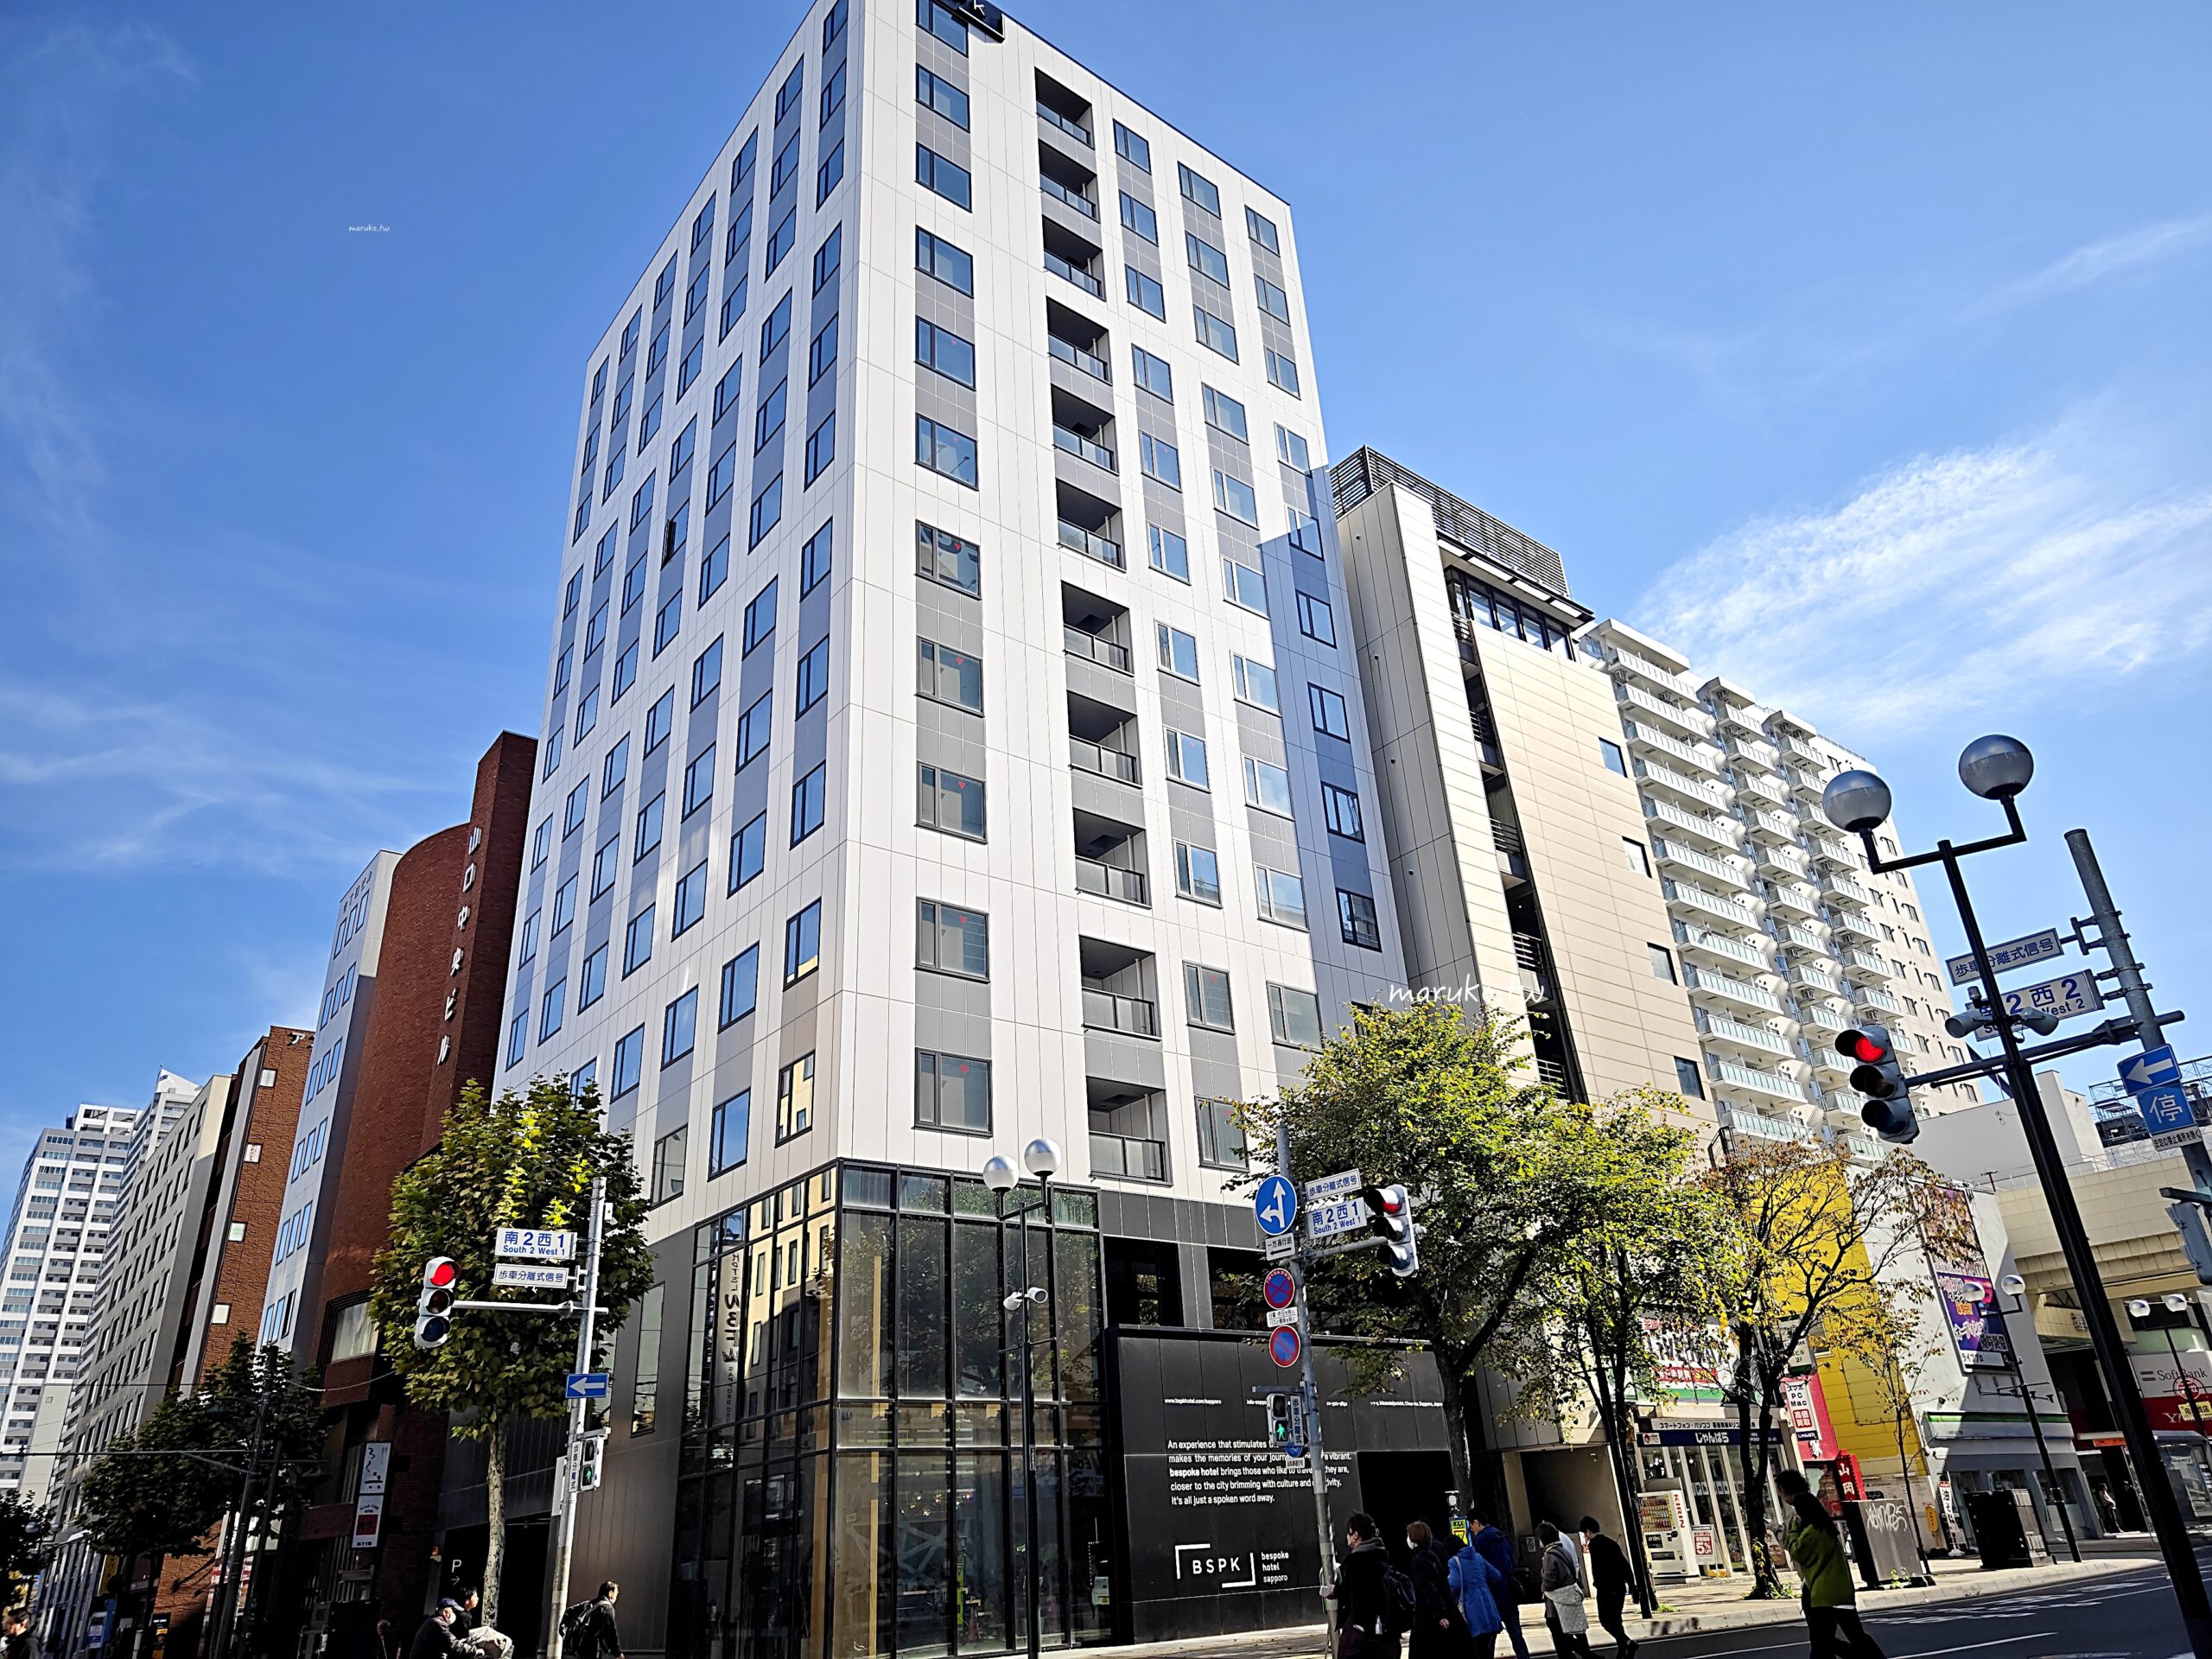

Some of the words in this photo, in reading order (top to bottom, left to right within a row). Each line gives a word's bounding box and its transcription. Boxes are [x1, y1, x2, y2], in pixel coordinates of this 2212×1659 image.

[436, 826, 482, 1066] 山口中央ビル
[2076, 998, 2086, 1009] 2
[2149, 1094, 2183, 1124] 停
[1308, 1178, 1358, 1196] 歩車分離式信号
[1313, 1224, 1332, 1236] South
[1340, 1218, 1356, 1228] West
[503, 1245, 527, 1254] South
[538, 1246, 558, 1255] West
[499, 1270, 564, 1283] 歩車分離式信号
[2157, 1368, 2209, 1381] SoftBank
[1167, 1440, 1178, 1449] An
[1179, 1440, 1216, 1451] experience
[1218, 1440, 1232, 1448] that
[1233, 1439, 1267, 1448] stimulates
[1168, 1454, 1192, 1463] makes
[1208, 1453, 1242, 1462] memories
[1253, 1453, 1267, 1464] your
[1169, 1467, 1200, 1478] bespoke
[1200, 1466, 1219, 1476] hotel
[1220, 1466, 1242, 1478] brings
[1243, 1465, 1261, 1475] those
[1262, 1465, 1275, 1475] who
[1276, 1465, 1287, 1474] like
[1170, 1482, 1192, 1491] closer
[1194, 1482, 1202, 1491] to
[1204, 1481, 1215, 1490] the
[1216, 1480, 1229, 1491] city
[1230, 1479, 1261, 1491] brimming
[1262, 1478, 1276, 1488] with
[1276, 1478, 1299, 1487] culture
[1184, 1495, 1192, 1504] all
[1193, 1495, 1207, 1506] just
[1213, 1494, 1238, 1505] spoken
[1239, 1493, 1256, 1503] word
[1256, 1494, 1275, 1503] away.
[1674, 1494, 1685, 1529] KIRIN
[1261, 1550, 1289, 1561] bespoke
[452, 1559, 462, 1573] P
[1192, 1557, 1241, 1574] BSPK
[1262, 1562, 1280, 1572] hotel
[1263, 1574, 1288, 1585] sapporo
